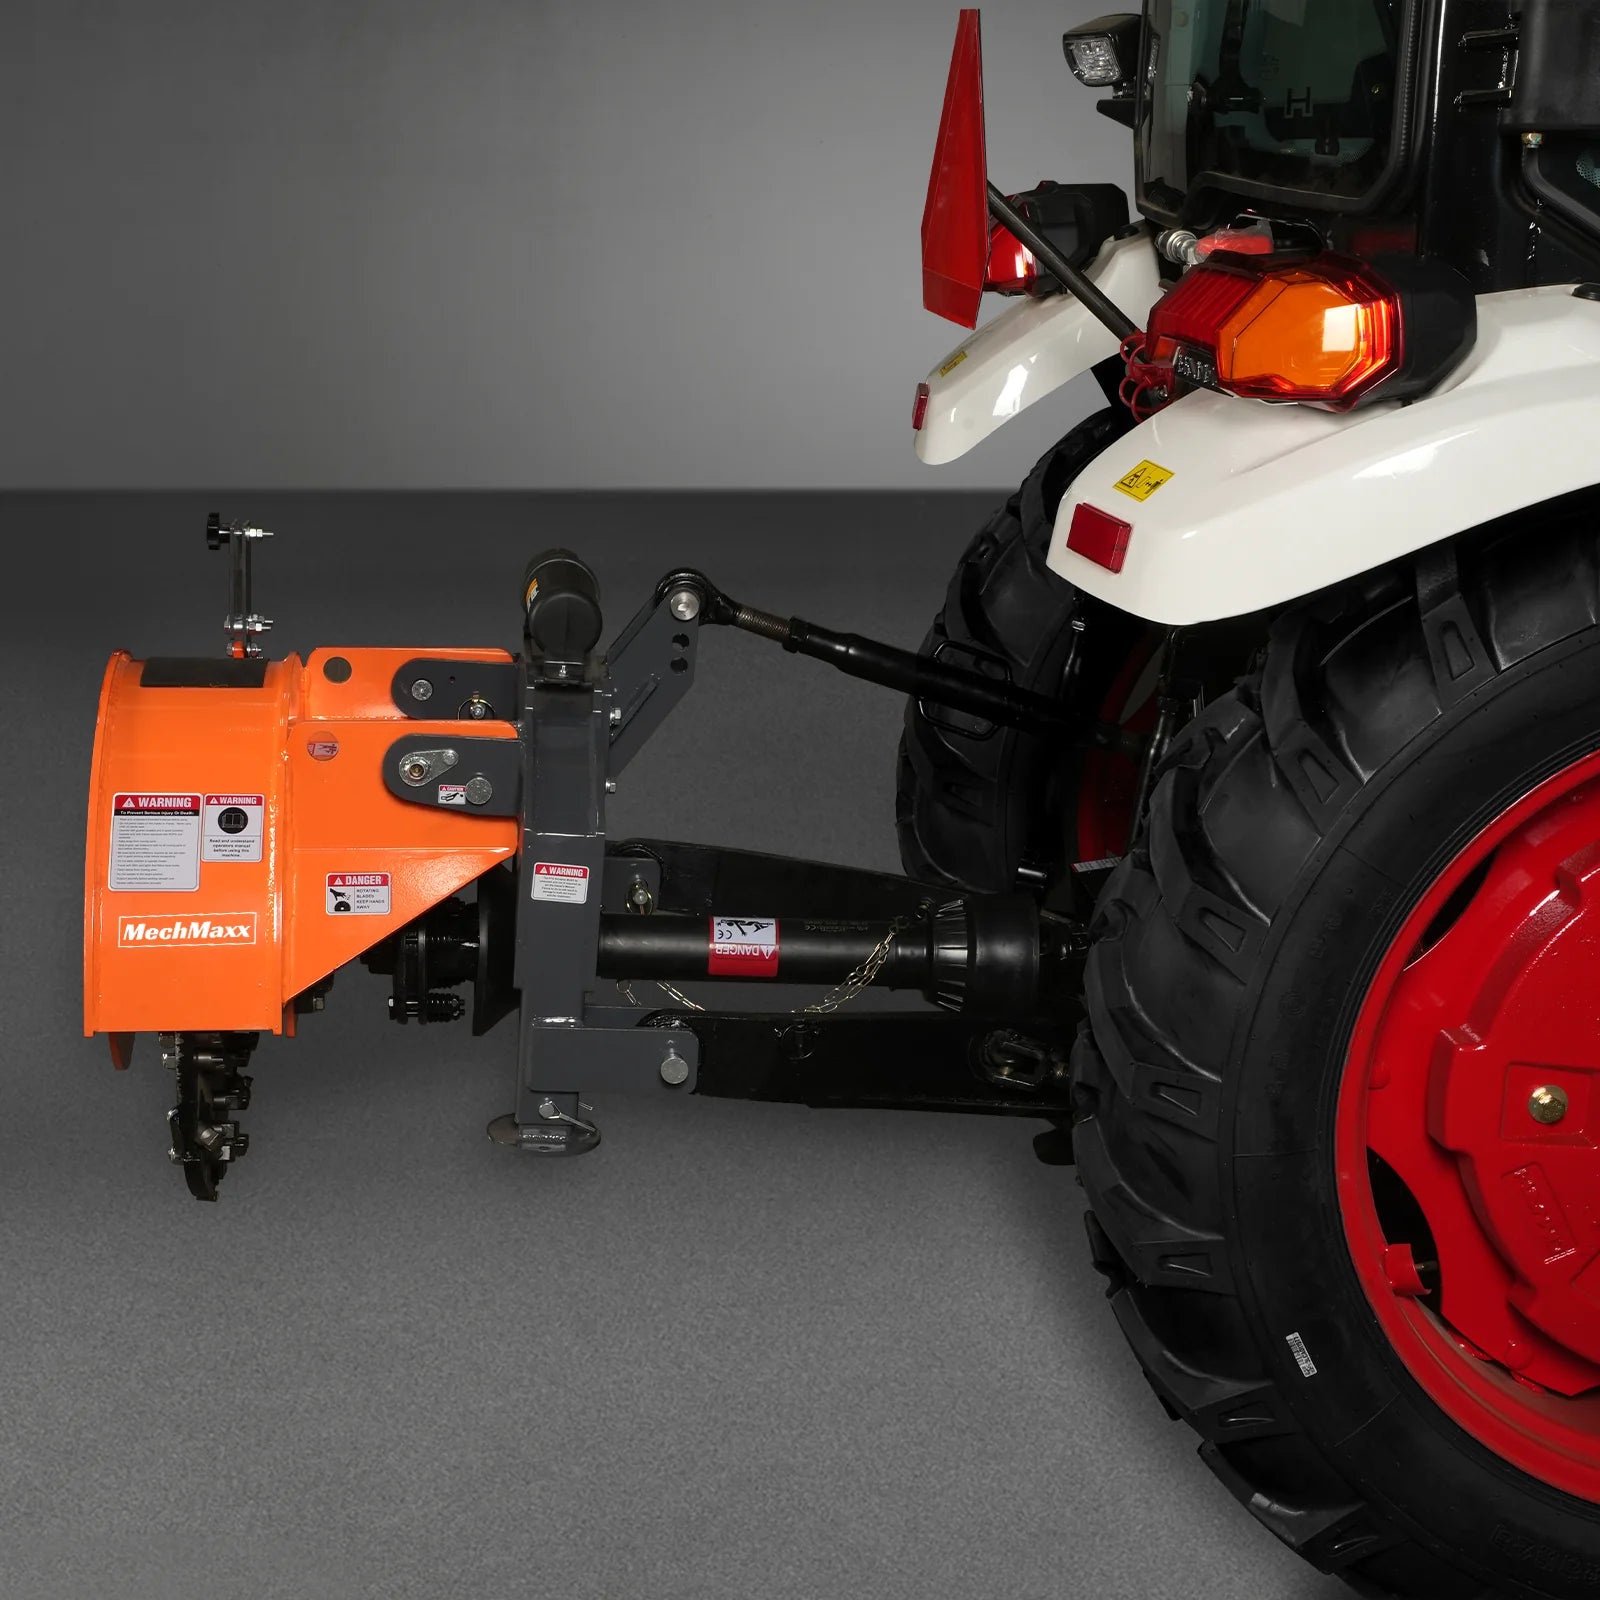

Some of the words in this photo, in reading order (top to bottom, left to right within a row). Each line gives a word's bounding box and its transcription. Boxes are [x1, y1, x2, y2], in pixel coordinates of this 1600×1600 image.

[138, 797, 192, 808] WARNING
[219, 796, 257, 805] WARNING
[549, 866, 583, 877] WARNING
[346, 876, 382, 885] DANGER
[123, 921, 251, 941] MechMaxx
[717, 929, 733, 940] CE
[715, 944, 760, 957] DANGER
